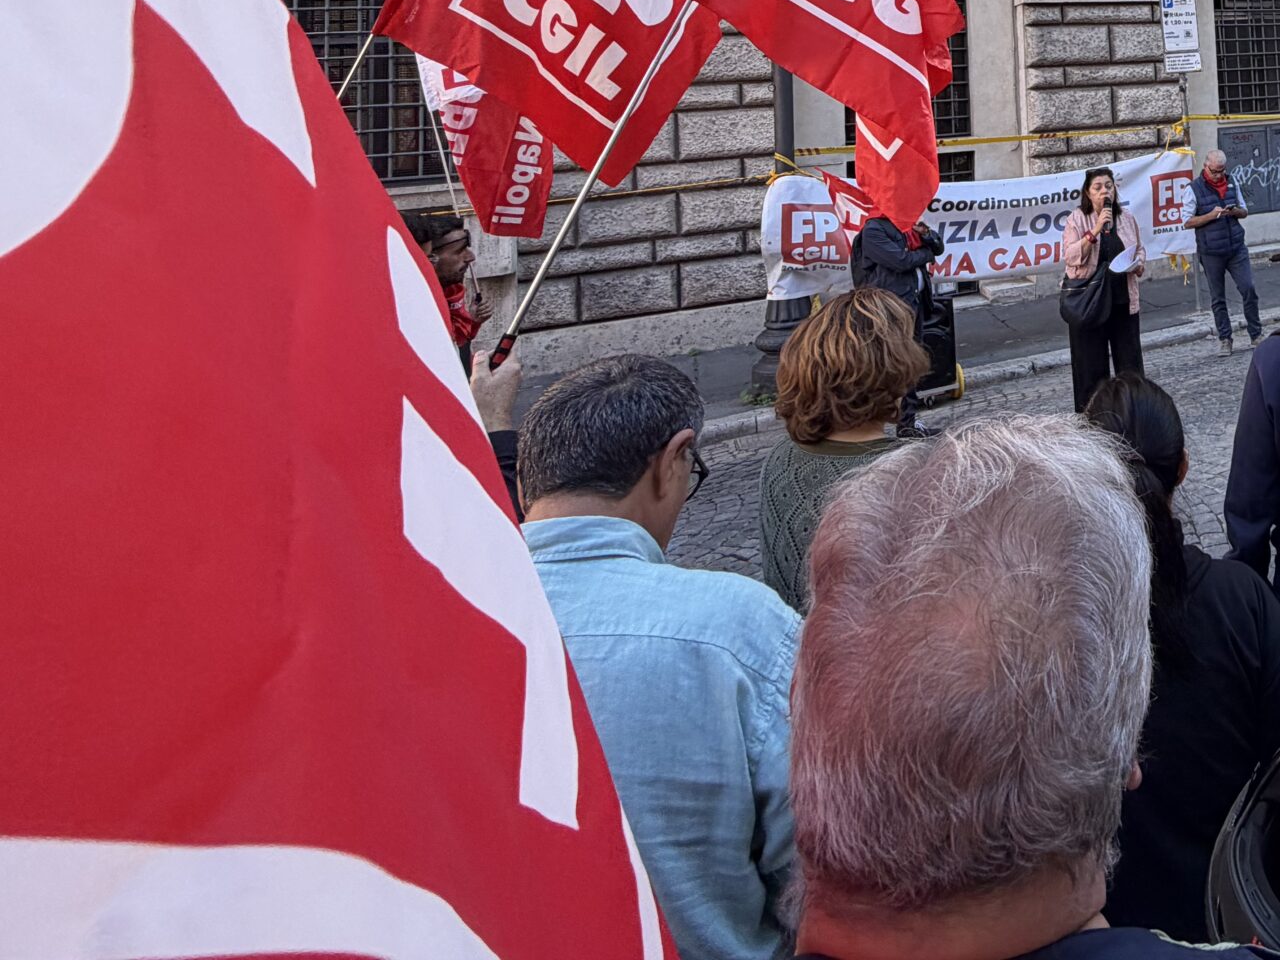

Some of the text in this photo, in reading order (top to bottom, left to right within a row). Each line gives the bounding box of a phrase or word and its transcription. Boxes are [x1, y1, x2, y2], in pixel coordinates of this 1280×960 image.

[927, 187, 1082, 213] Coordinamento
[1158, 206, 1184, 223] CG
[791, 211, 839, 244] FP
[937, 210, 1073, 244] IZIA LOC
[791, 245, 840, 261] CGIL
[928, 241, 1061, 278] MA CAPI
